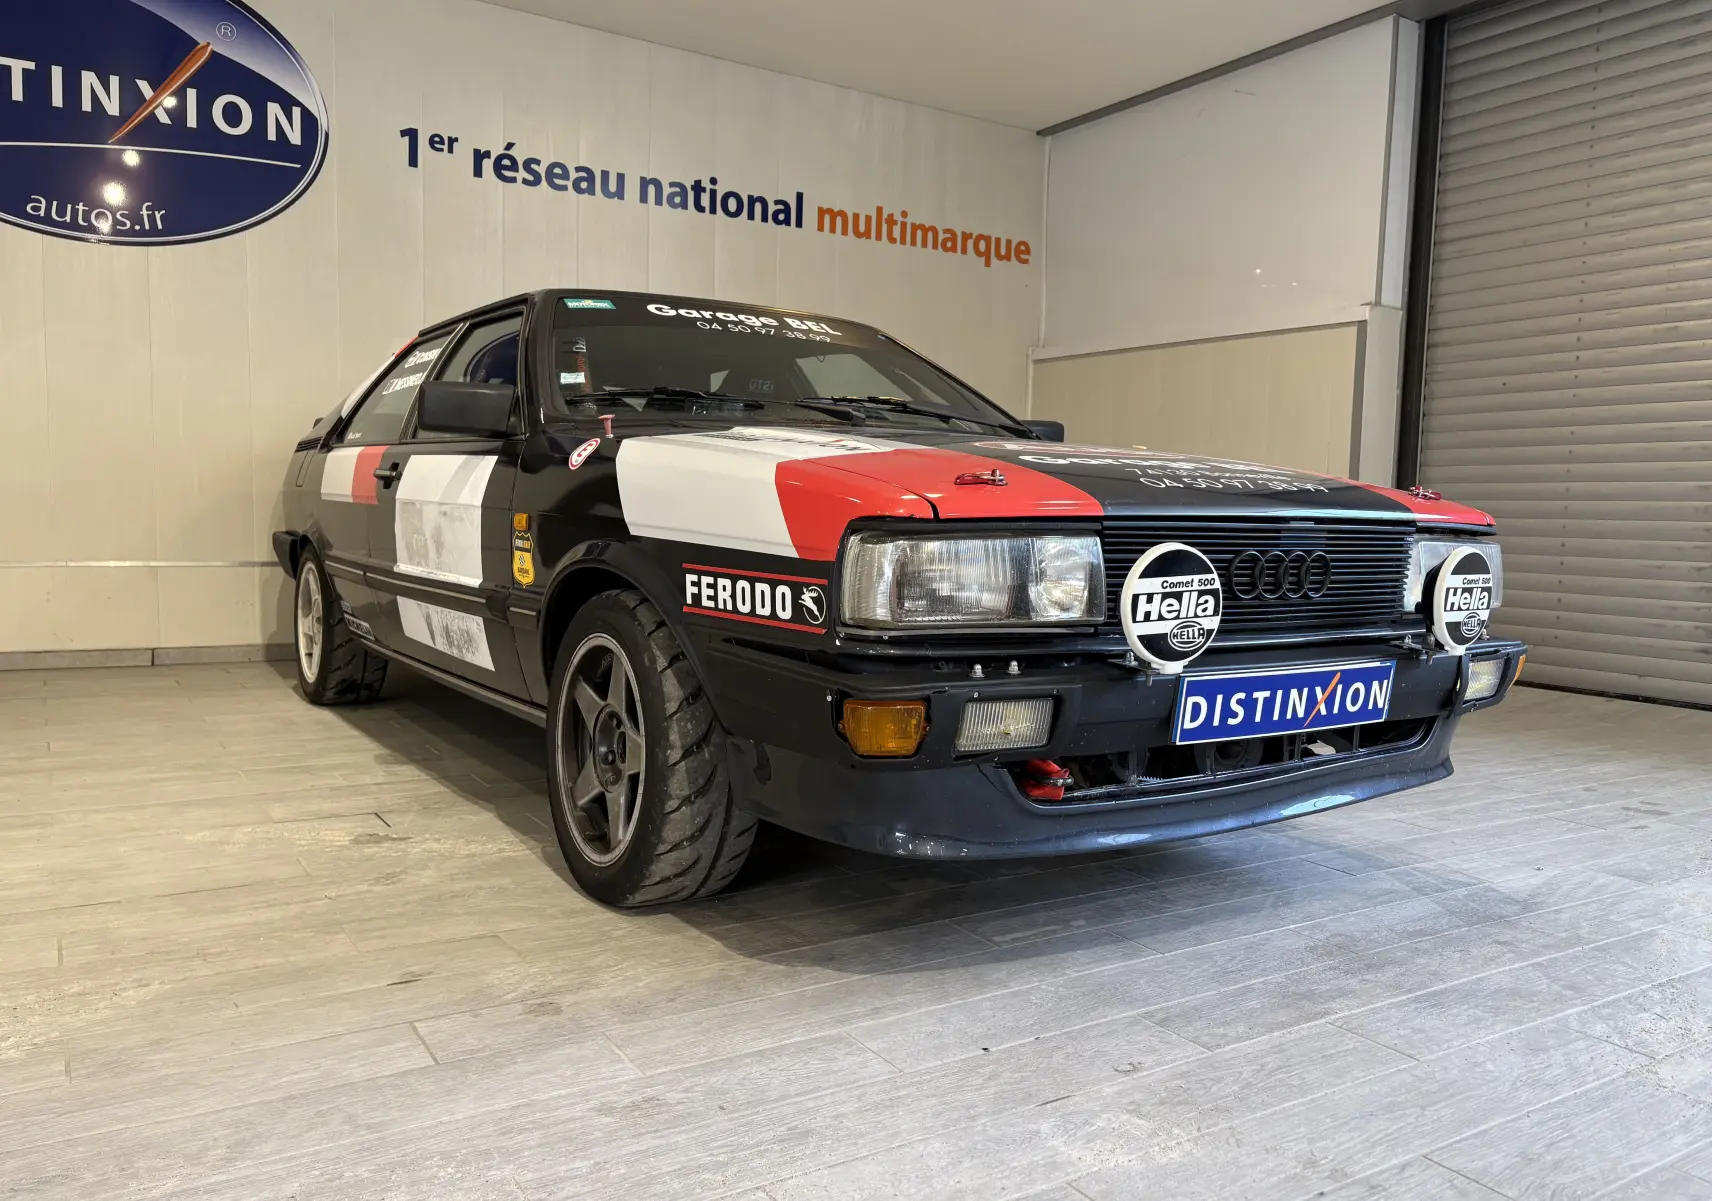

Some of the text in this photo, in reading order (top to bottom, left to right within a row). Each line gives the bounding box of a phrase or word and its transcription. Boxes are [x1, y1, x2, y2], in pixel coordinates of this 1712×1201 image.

[26, 194, 166, 231] autos.fr
[472, 142, 626, 201] réseau
[638, 177, 804, 229] national
[816, 206, 1032, 268] multimarque
[646, 303, 842, 336] Garage BEL
[696, 321, 831, 343] 04 50 97 38 99
[1139, 477, 1184, 488] 04
[1181, 478, 1223, 488] 50
[1219, 479, 1254, 489] 97
[1292, 482, 1329, 493] 99
[1161, 577, 1216, 590] Comet 500
[1462, 577, 1491, 586] Comet 500
[685, 573, 792, 620] FERODO
[1135, 591, 1215, 622] Hella
[1445, 587, 1489, 611] Hella
[1172, 626, 1205, 641] HELLA
[1463, 617, 1481, 629] HELLA
[1183, 676, 1389, 730] DISTINXION
